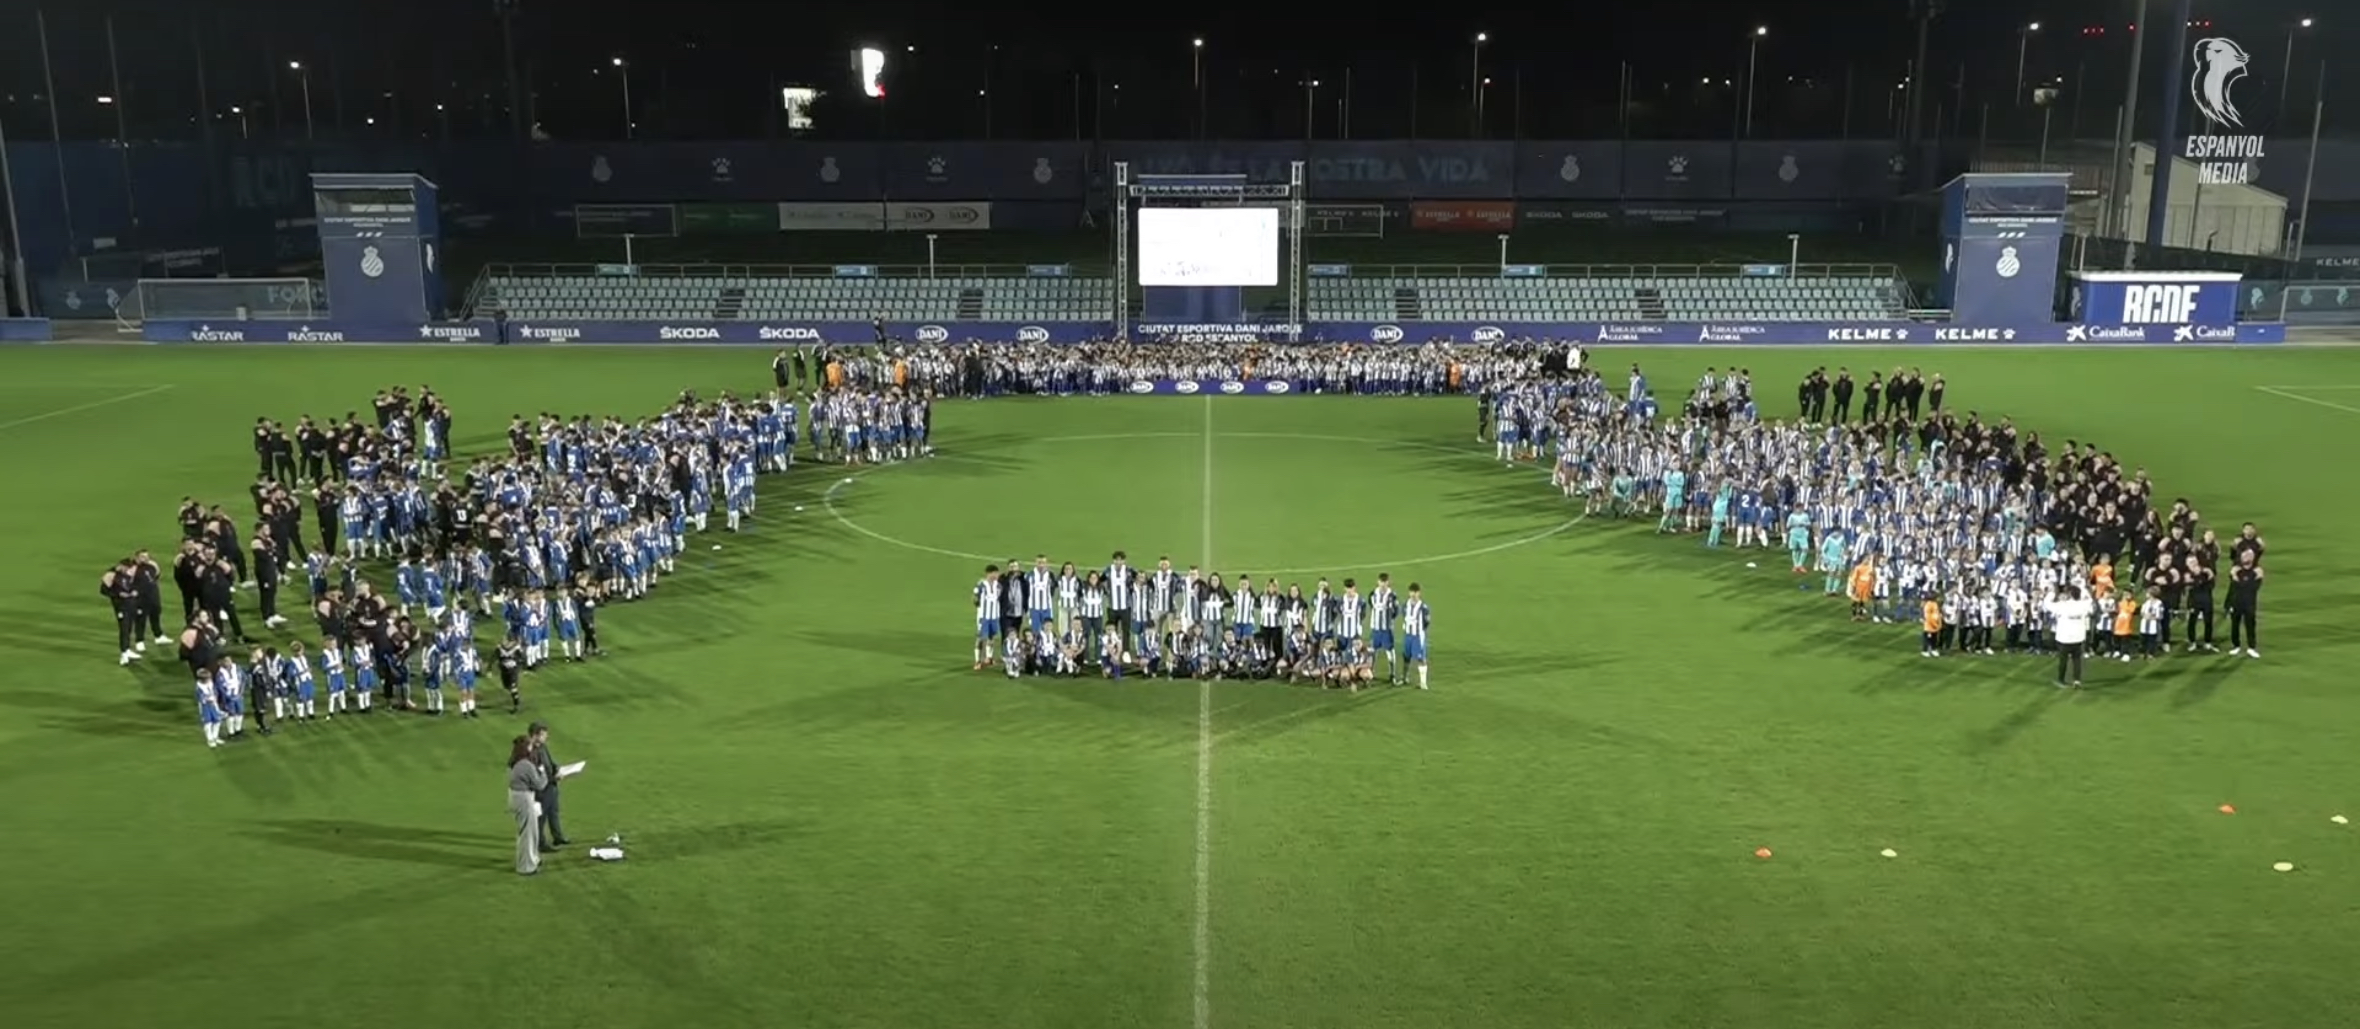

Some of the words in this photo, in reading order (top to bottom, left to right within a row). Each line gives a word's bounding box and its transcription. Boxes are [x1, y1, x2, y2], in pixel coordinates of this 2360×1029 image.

[434, 328, 481, 338] ESTRELLA
[533, 328, 581, 338] ESTRELLA
[1137, 324, 1176, 333] CIUTAT
[1177, 324, 1234, 333] ESPORTIVA
[1235, 324, 1260, 333] DANI
[1372, 328, 1398, 340] DANI
[2089, 325, 2145, 338] CaixaBank
[287, 331, 344, 341] RASTAR
[918, 328, 945, 341] DANI
[1018, 328, 1045, 342] DANI
[1828, 329, 1892, 340] KELME
[1935, 329, 1999, 340] KELME
[1742, 494, 1751, 508] 2
